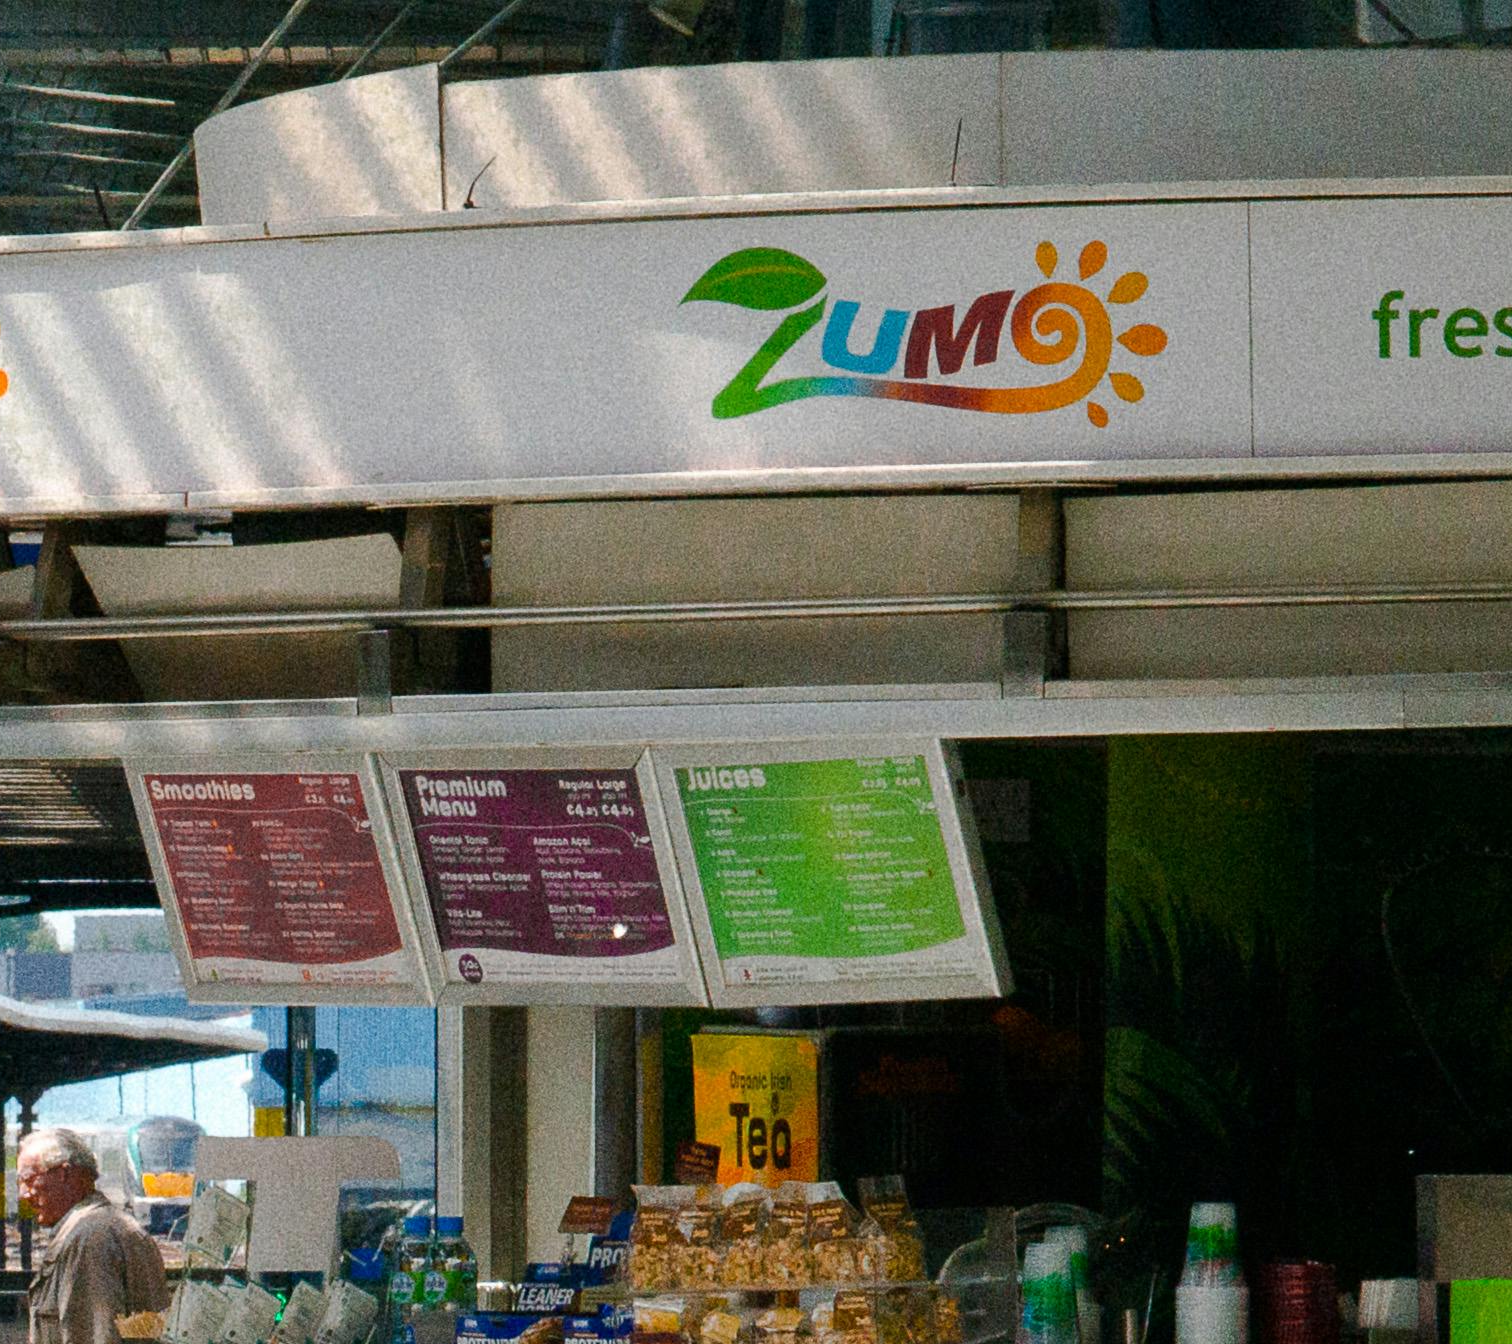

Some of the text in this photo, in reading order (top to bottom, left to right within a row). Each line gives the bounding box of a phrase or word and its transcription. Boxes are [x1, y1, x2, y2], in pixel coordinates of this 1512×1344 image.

[680, 246, 1114, 420] ZUMO
[150, 779, 257, 801] Smoothies
[415, 775, 508, 799] Premium
[687, 767, 767, 791] Juices
[420, 797, 477, 817] Menu
[729, 1069, 770, 1094] Organic
[728, 1101, 793, 1171] Tea
[518, 1288, 576, 1306] LEANER
